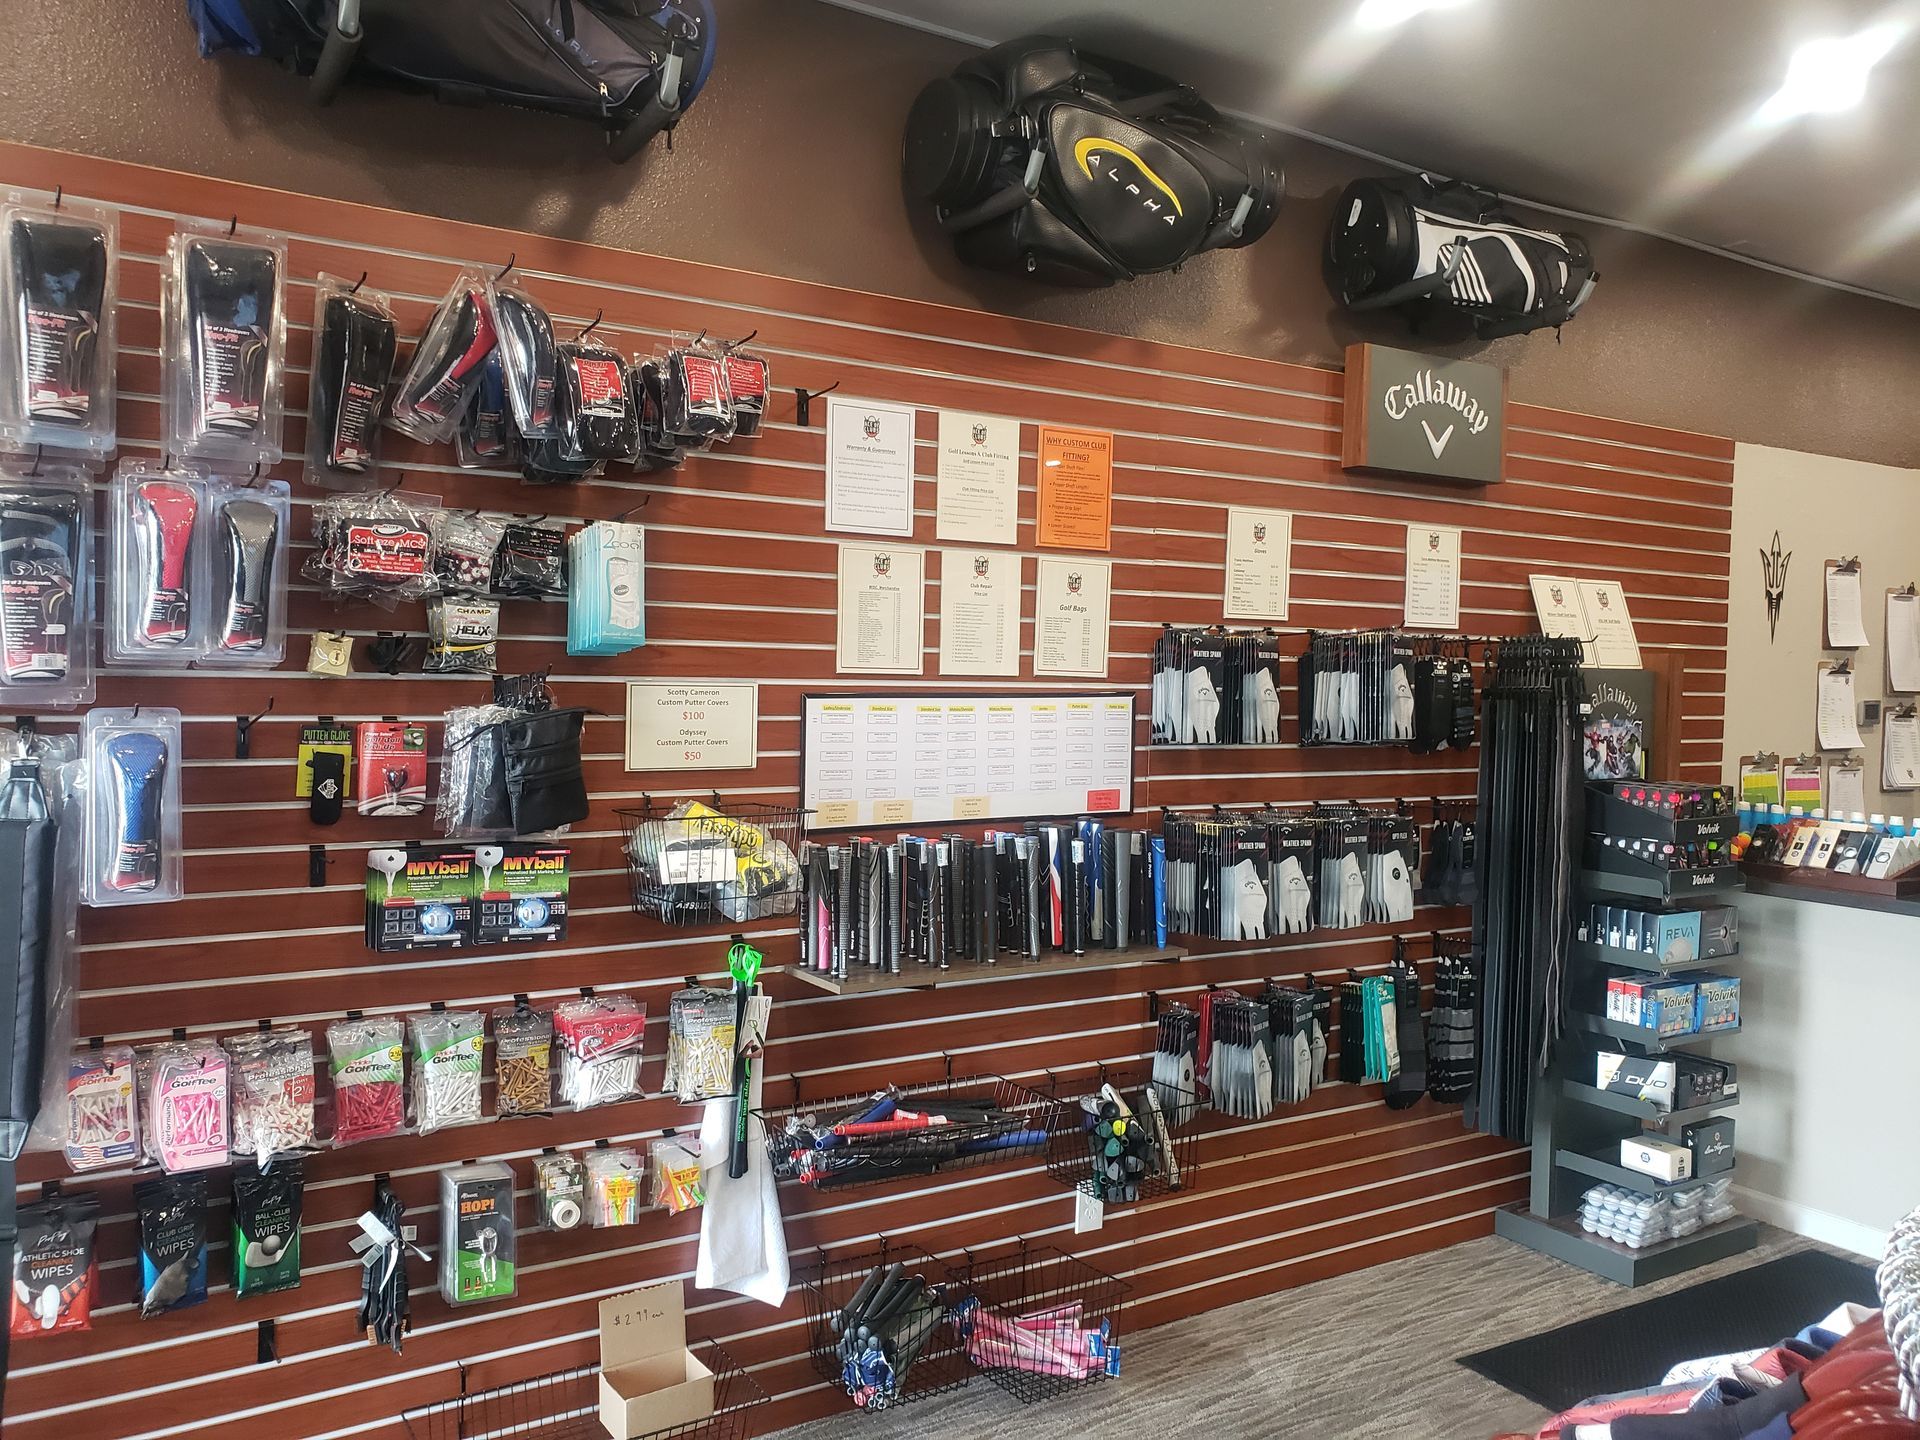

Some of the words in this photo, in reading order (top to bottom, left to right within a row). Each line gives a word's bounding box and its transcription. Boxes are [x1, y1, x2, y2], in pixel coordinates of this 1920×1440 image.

[1087, 155, 1176, 226] ALPHA
[1384, 368, 1489, 435] Callaway
[1046, 437, 1061, 445] WHY
[1063, 438, 1090, 448] CUSTOM
[1091, 441, 1107, 450] CLUB
[1062, 452, 1090, 461] FITTING?
[457, 607, 492, 616] CHAMP
[1060, 604, 1072, 612] Golf
[1073, 605, 1088, 613] Bags
[667, 689, 689, 697] Scotty
[1589, 682, 1639, 717] allaway
[682, 711, 705, 720] $100
[304, 730, 329, 740] PUTTER
[330, 730, 351, 740] GLOVE
[679, 729, 707, 737] Odyssey
[684, 751, 702, 761] $50
[1697, 823, 1720, 835] Volvik
[407, 860, 470, 876] MYball
[504, 856, 565, 871] MYball
[1692, 873, 1716, 886] Volvik
[1665, 928, 1695, 941] REVA
[1663, 993, 1692, 1009] Volvik
[1708, 987, 1736, 1003] Volvik
[432, 1053, 475, 1065] GolfTee
[344, 1063, 392, 1074] GolfTee
[171, 1076, 217, 1090] GolfTee
[1624, 1074, 1668, 1089] DUO
[164, 1096, 172, 1147] Performance
[460, 1198, 495, 1214] HOP!
[255, 1212, 270, 1221] BALL
[273, 1207, 291, 1217] CLUB
[255, 1215, 290, 1228] CLEANING
[156, 1228, 176, 1240] CLUB
[177, 1223, 195, 1235] GRIP
[254, 1221, 291, 1238] WIPES
[156, 1238, 195, 1257] WIPES
[21, 1250, 61, 1263] ATHLETIC
[61, 1247, 85, 1257] SHOE
[31, 1257, 74, 1268] CLEANING
[31, 1264, 74, 1280] WIPES
